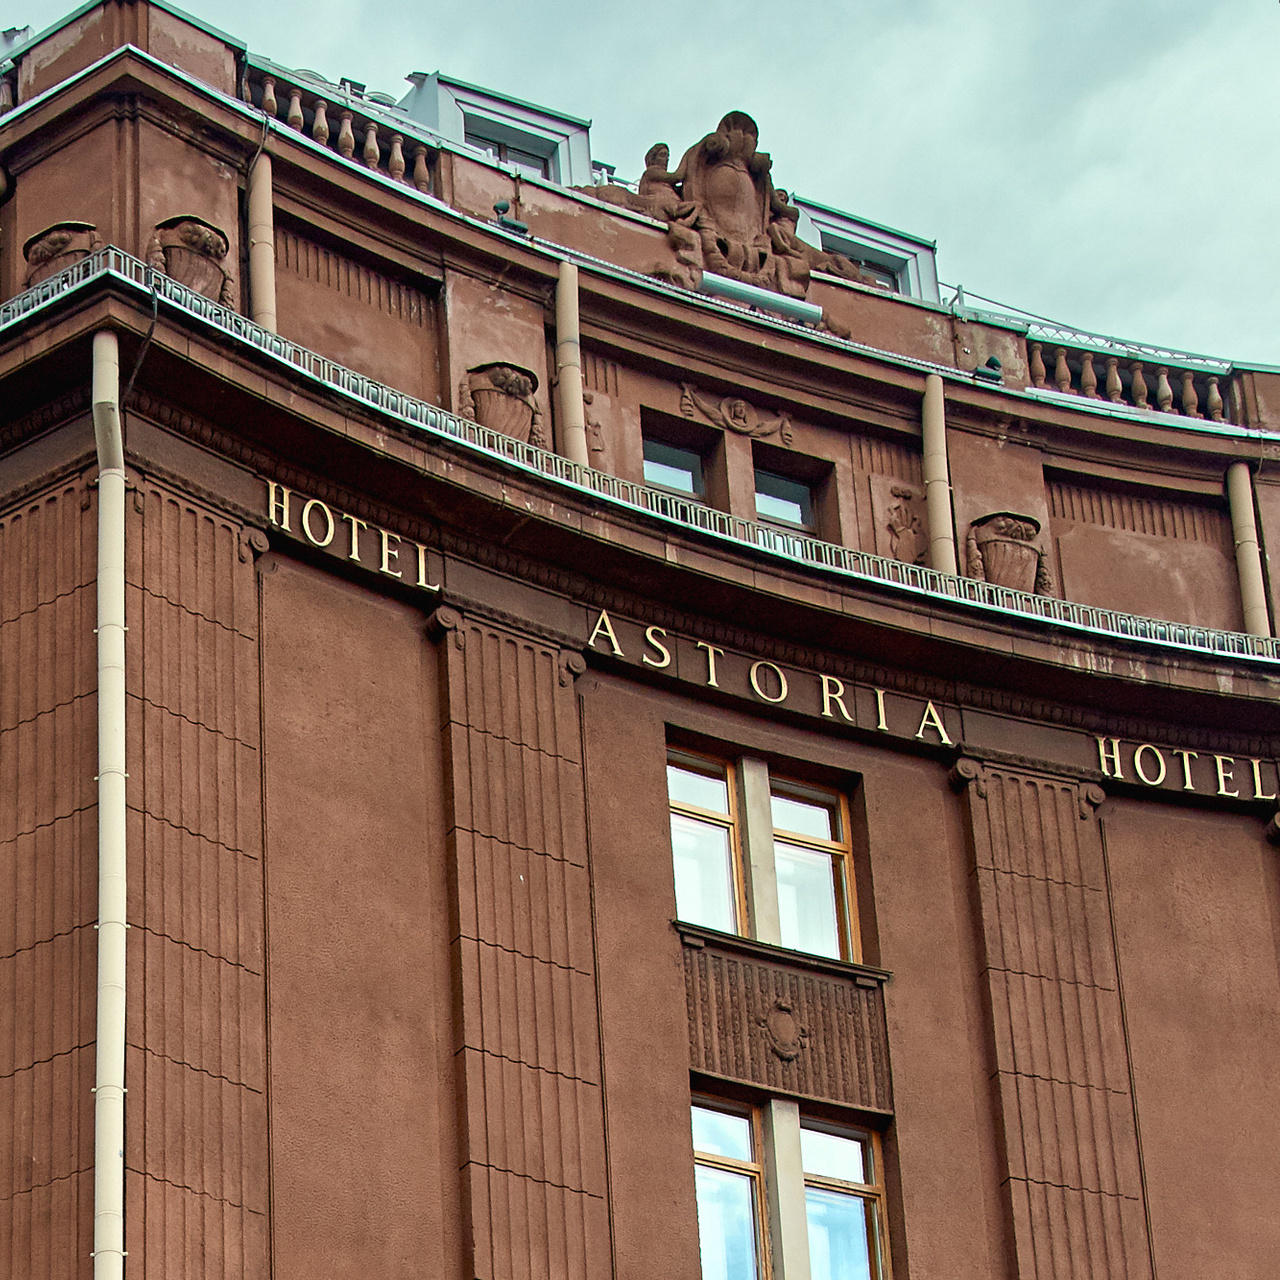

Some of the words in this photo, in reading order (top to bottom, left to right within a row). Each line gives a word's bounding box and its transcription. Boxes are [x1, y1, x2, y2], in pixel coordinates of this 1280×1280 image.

[267, 480, 440, 592] HOTEL
[588, 609, 953, 745] ASTORIA
[1095, 735, 1277, 800] HOTEL
